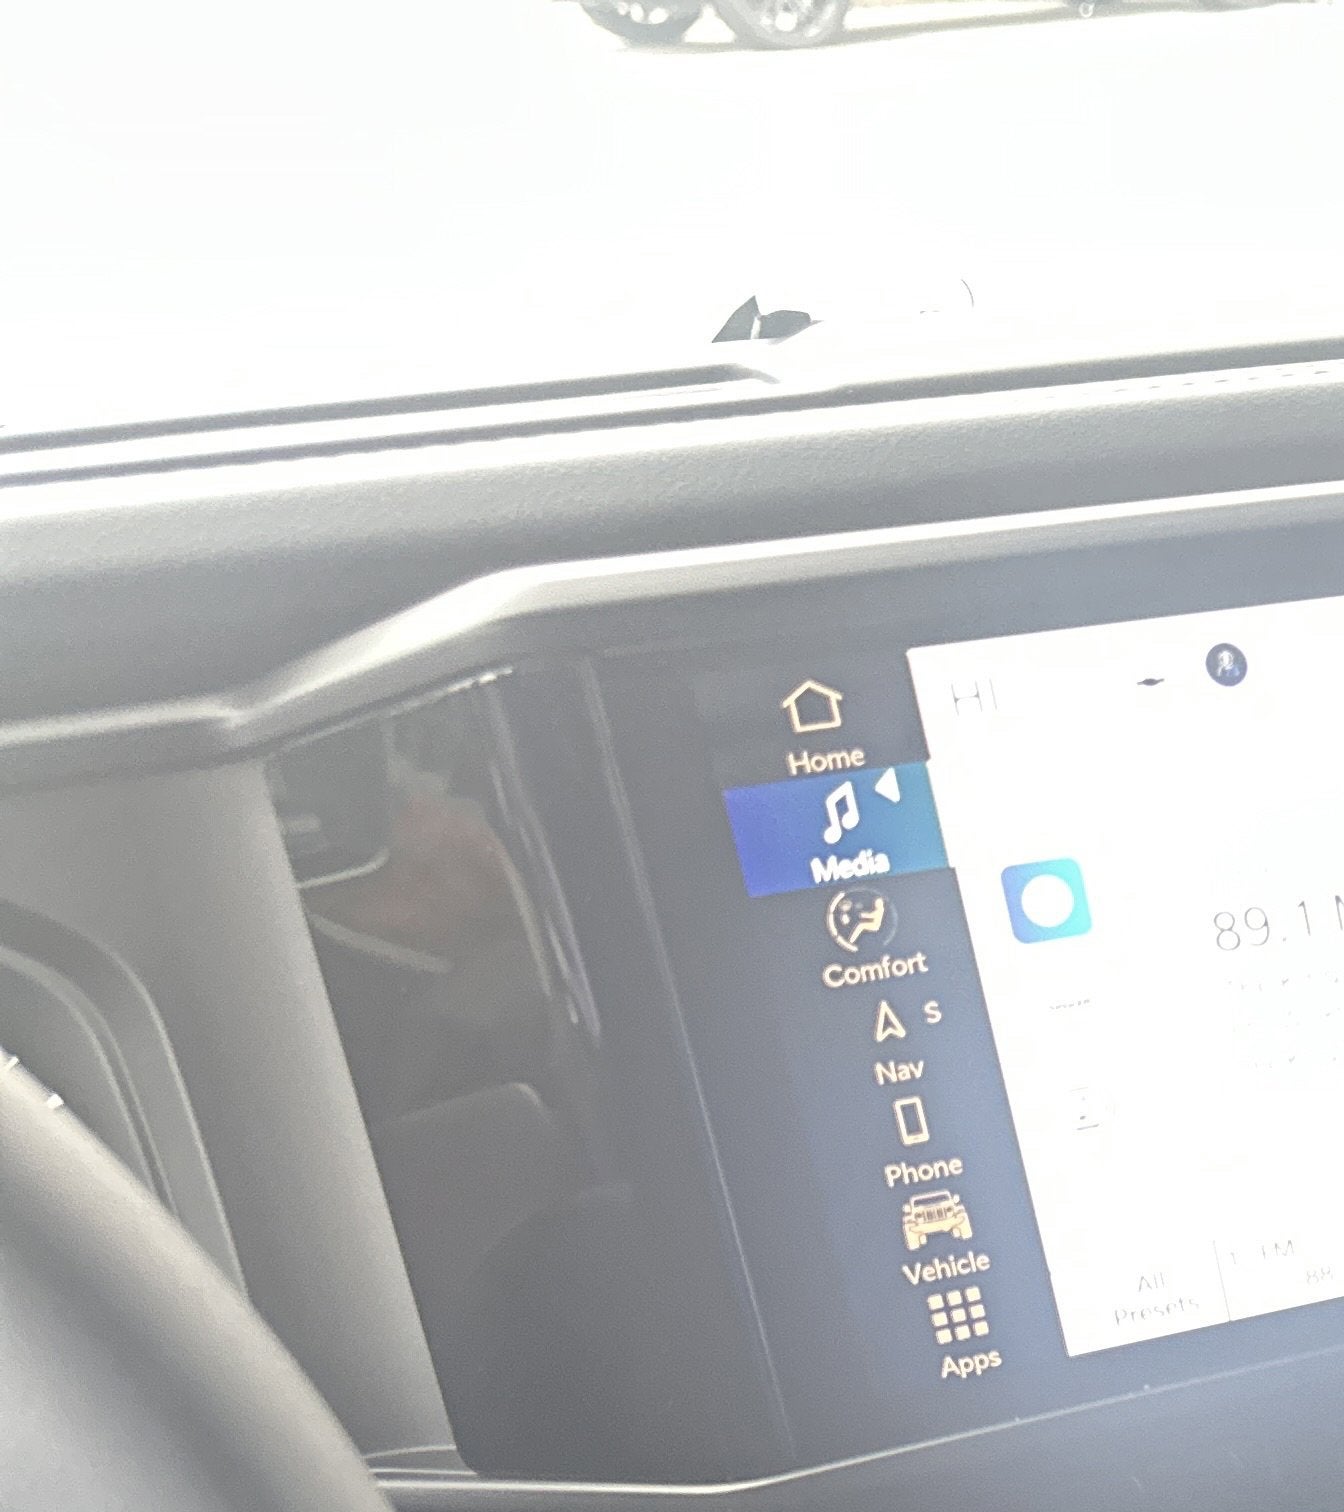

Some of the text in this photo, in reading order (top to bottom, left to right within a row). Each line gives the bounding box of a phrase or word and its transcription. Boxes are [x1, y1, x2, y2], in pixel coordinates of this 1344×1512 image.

[951, 678, 998, 716] HI
[788, 747, 865, 776] Home
[810, 848, 890, 884] Media
[1213, 899, 1312, 952] 89.1
[822, 951, 929, 989] Comfort
[924, 1001, 943, 1025] S
[875, 1059, 925, 1085] Nav
[884, 1155, 964, 1187] Phone
[902, 1250, 991, 1286] Vehicle
[1138, 1271, 1165, 1292] All
[1114, 1297, 1200, 1327] Presets
[940, 1348, 1002, 1379] Apps
